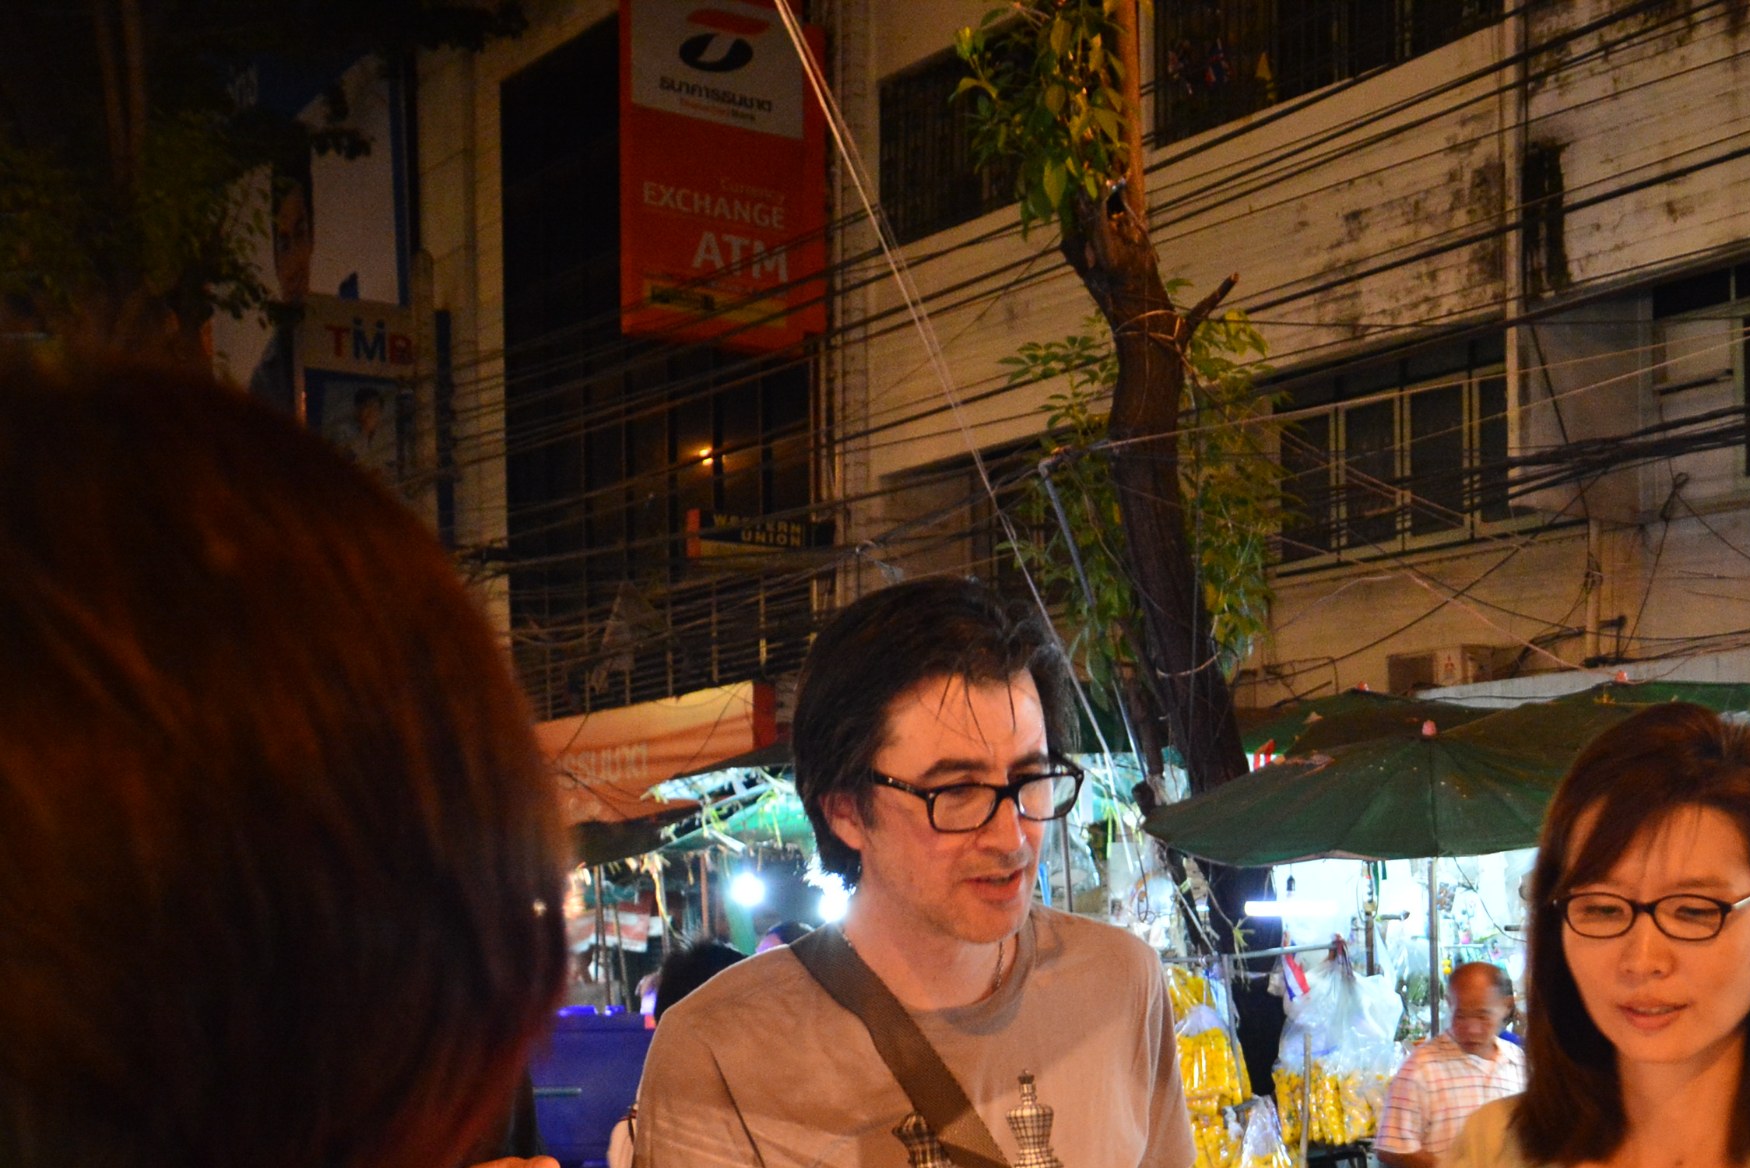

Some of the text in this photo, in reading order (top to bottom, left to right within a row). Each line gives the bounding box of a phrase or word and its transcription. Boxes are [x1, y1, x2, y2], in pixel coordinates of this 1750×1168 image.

[643, 181, 785, 229] EXCHANGE
[692, 231, 789, 284] ATM
[324, 318, 417, 367] TMB
[741, 529, 802, 547] UNION
